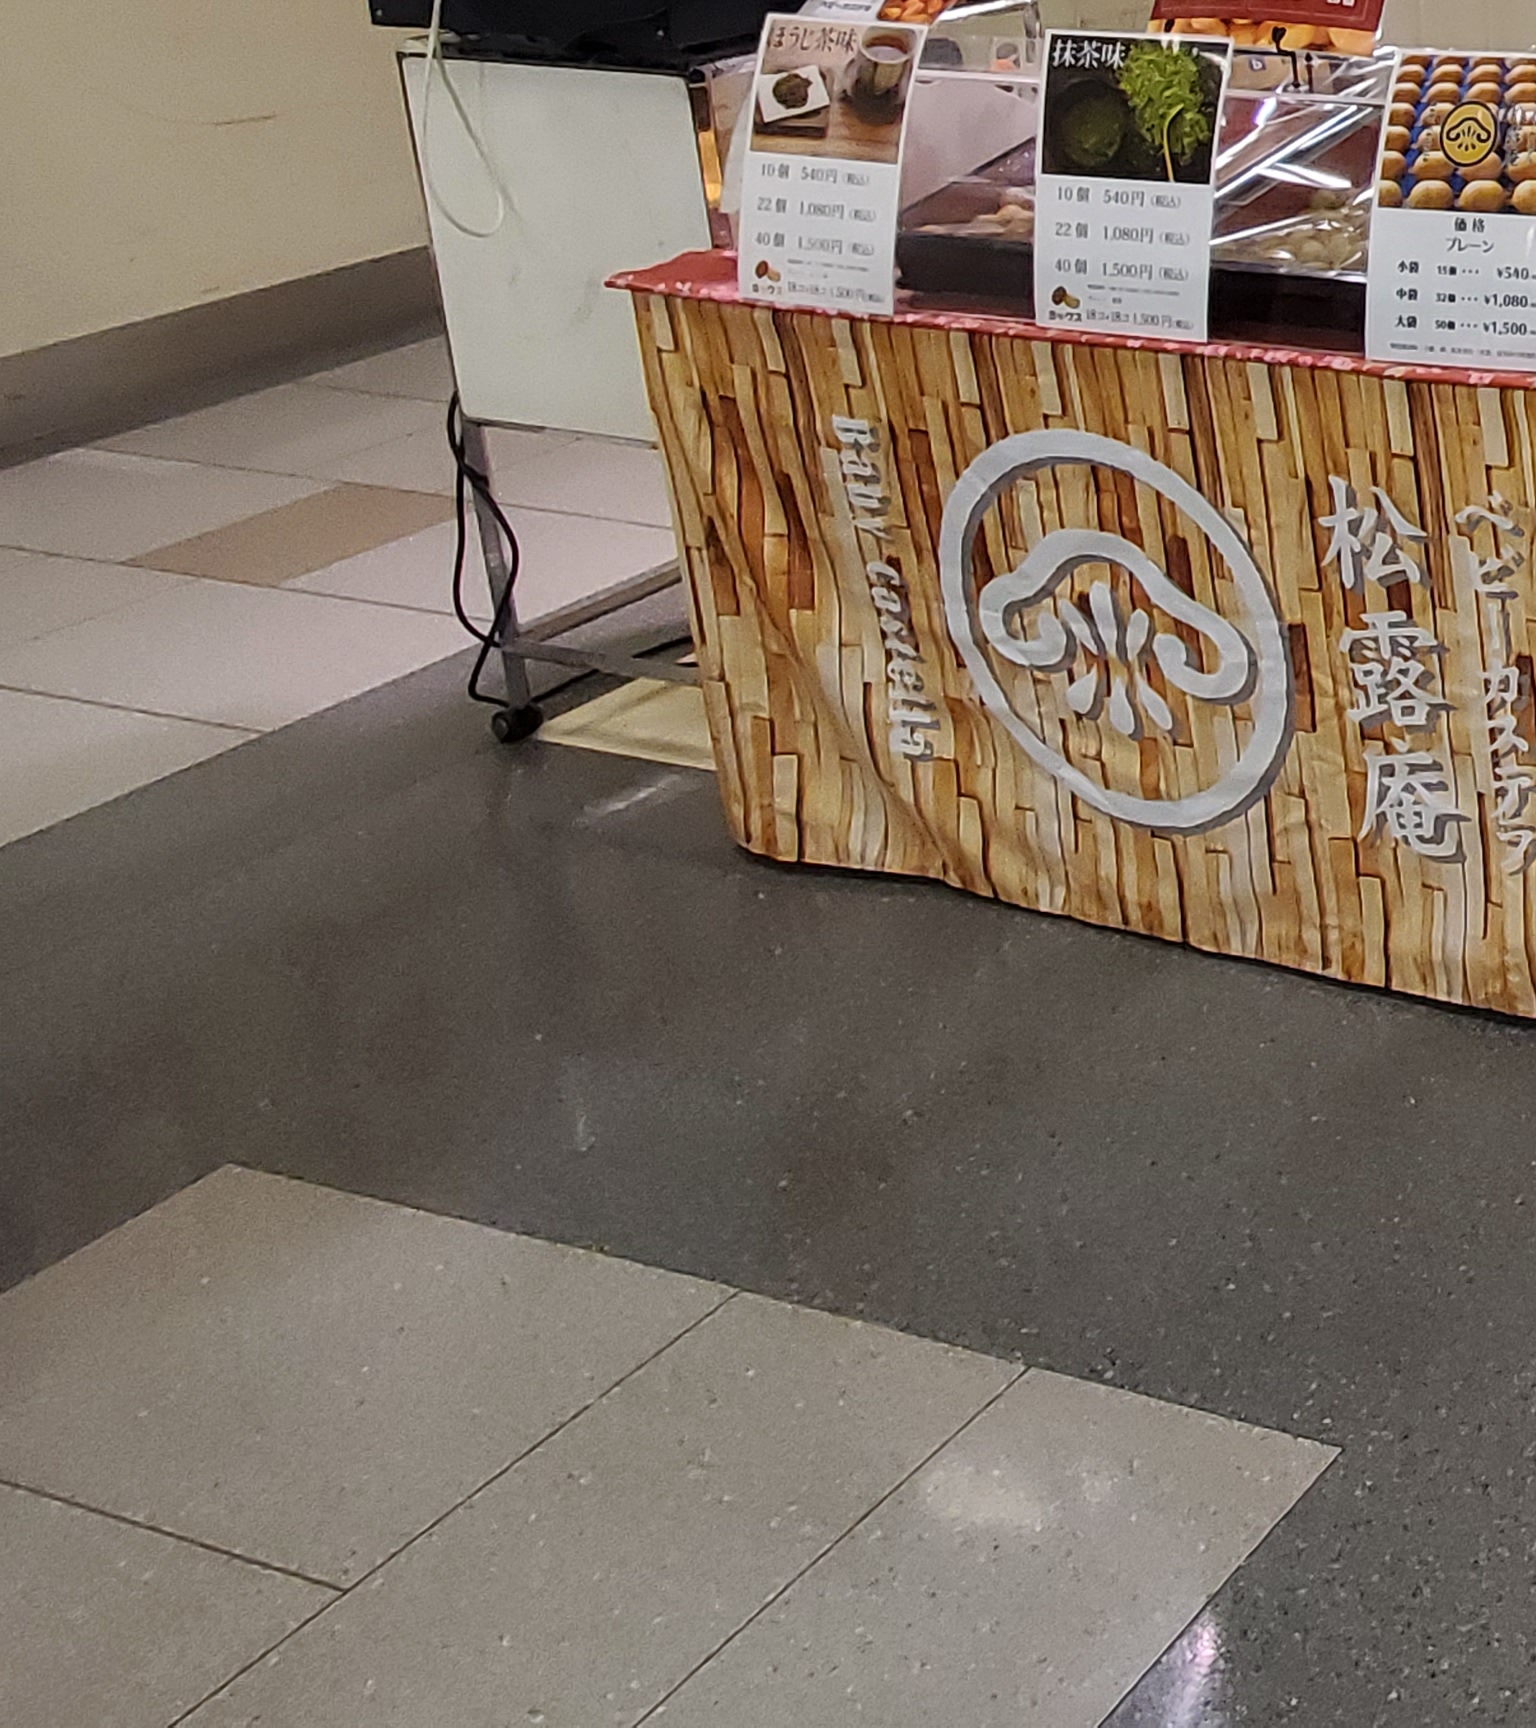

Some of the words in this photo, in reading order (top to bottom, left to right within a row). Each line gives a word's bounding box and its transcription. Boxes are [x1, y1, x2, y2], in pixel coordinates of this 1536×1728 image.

[767, 25, 857, 53] ほうじ茶味
[1052, 38, 1127, 70] 抹茶味
[1057, 186, 1090, 203] 10個
[1103, 188, 1145, 207] 540円
[1055, 222, 1088, 239] 22個
[1454, 217, 1486, 233] 価格
[1445, 236, 1495, 253] プレーン
[1055, 257, 1088, 275] 40個
[832, 414, 890, 540] Baby
[1319, 475, 1466, 862] 松露庵
